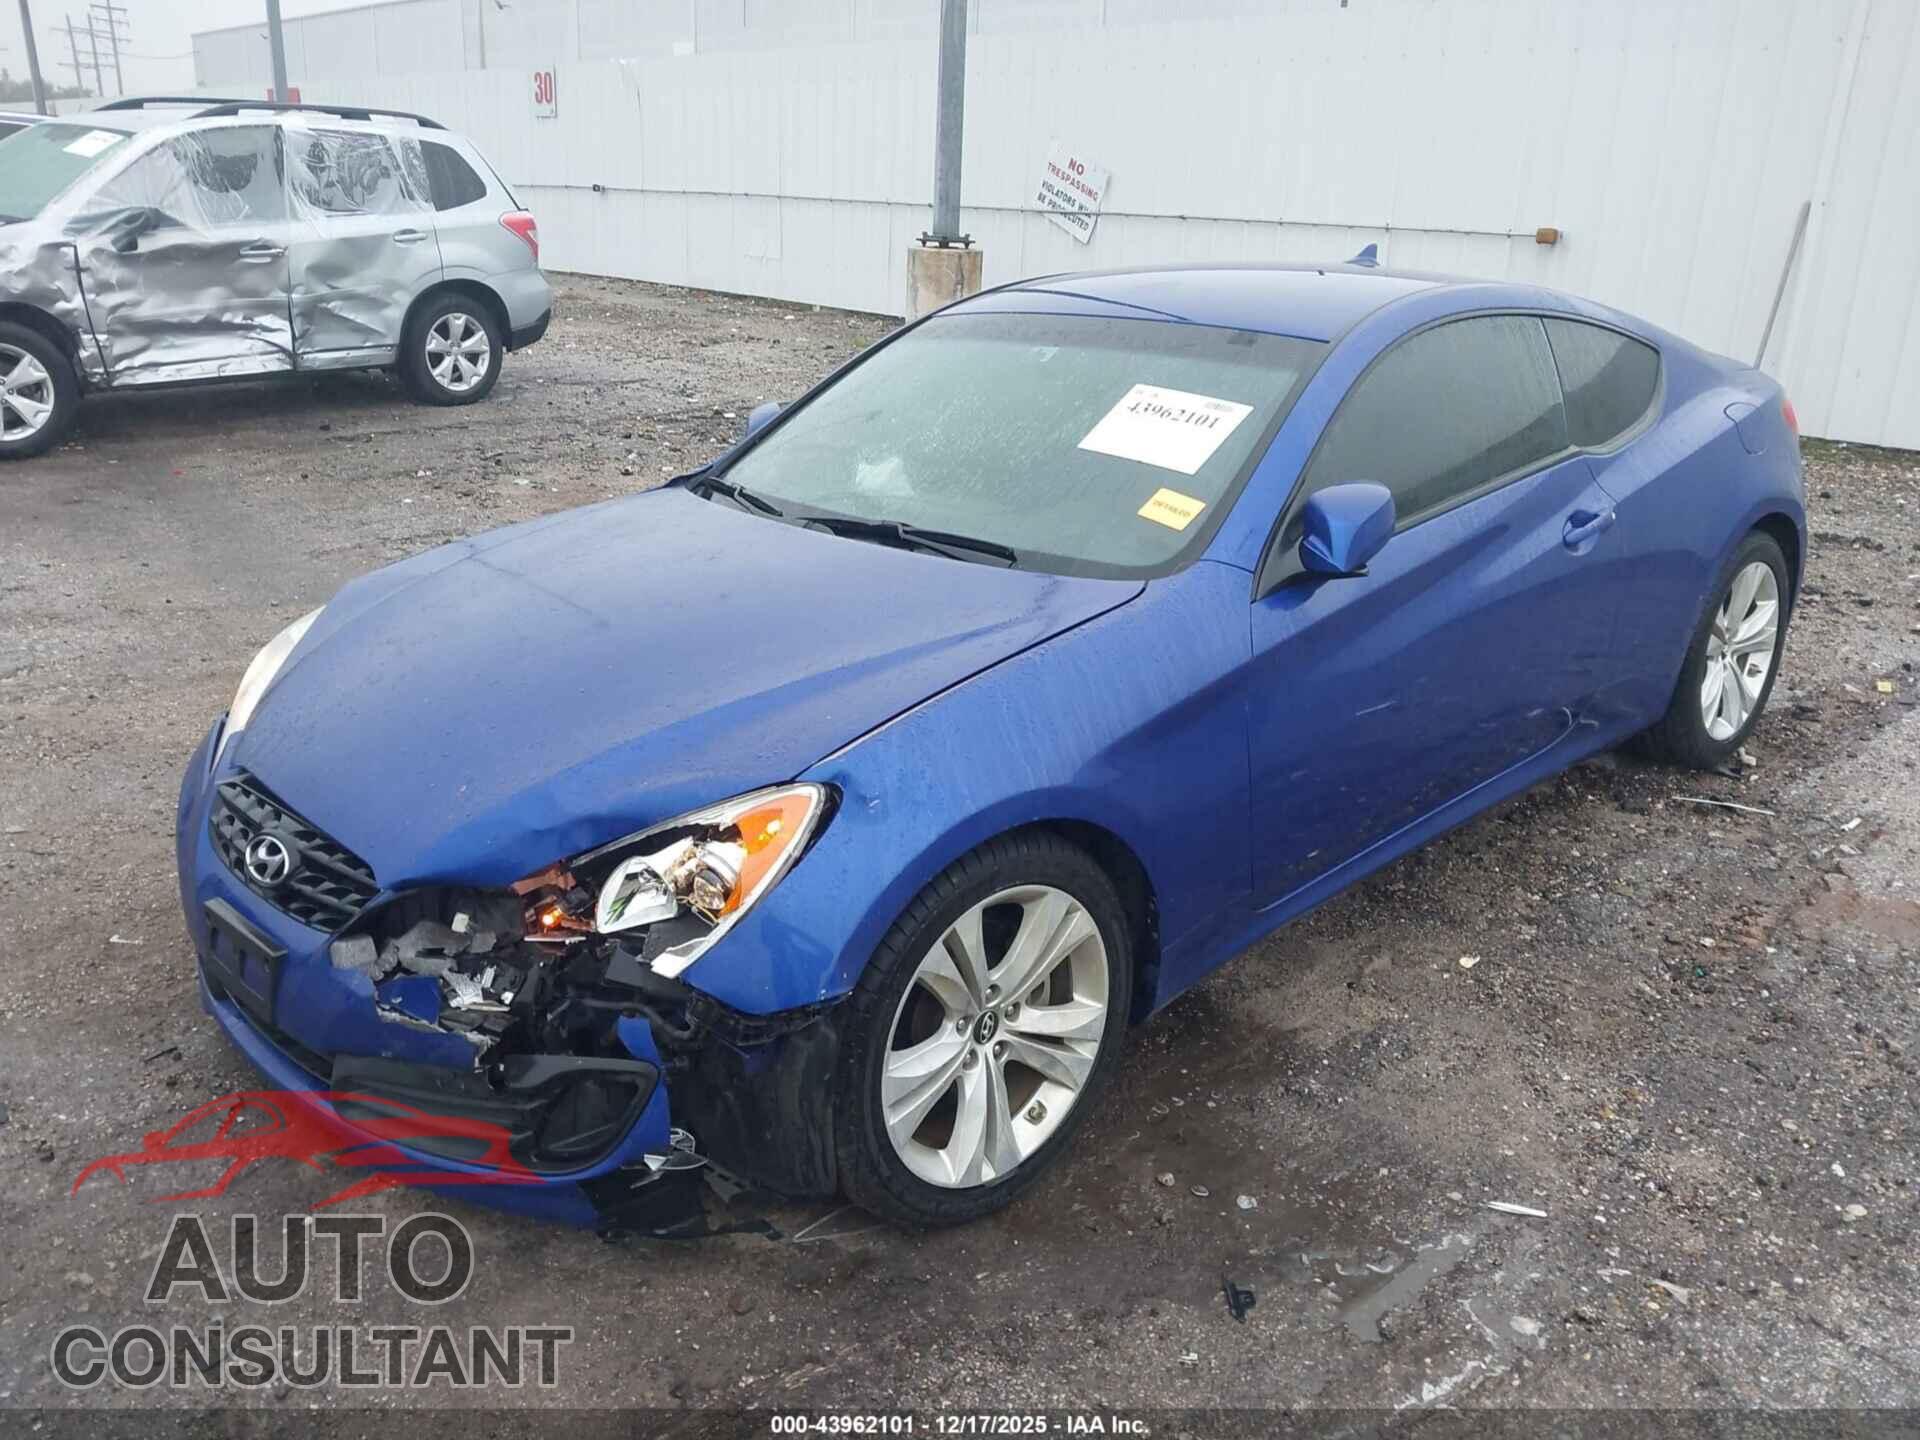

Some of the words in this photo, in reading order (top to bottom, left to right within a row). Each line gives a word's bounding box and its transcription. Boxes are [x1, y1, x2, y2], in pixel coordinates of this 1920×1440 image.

[534, 71, 553, 104] 30
[1047, 161, 1099, 202] TRESPASSING
[1068, 157, 1085, 176] NO
[1042, 180, 1077, 207] VIOLATORS
